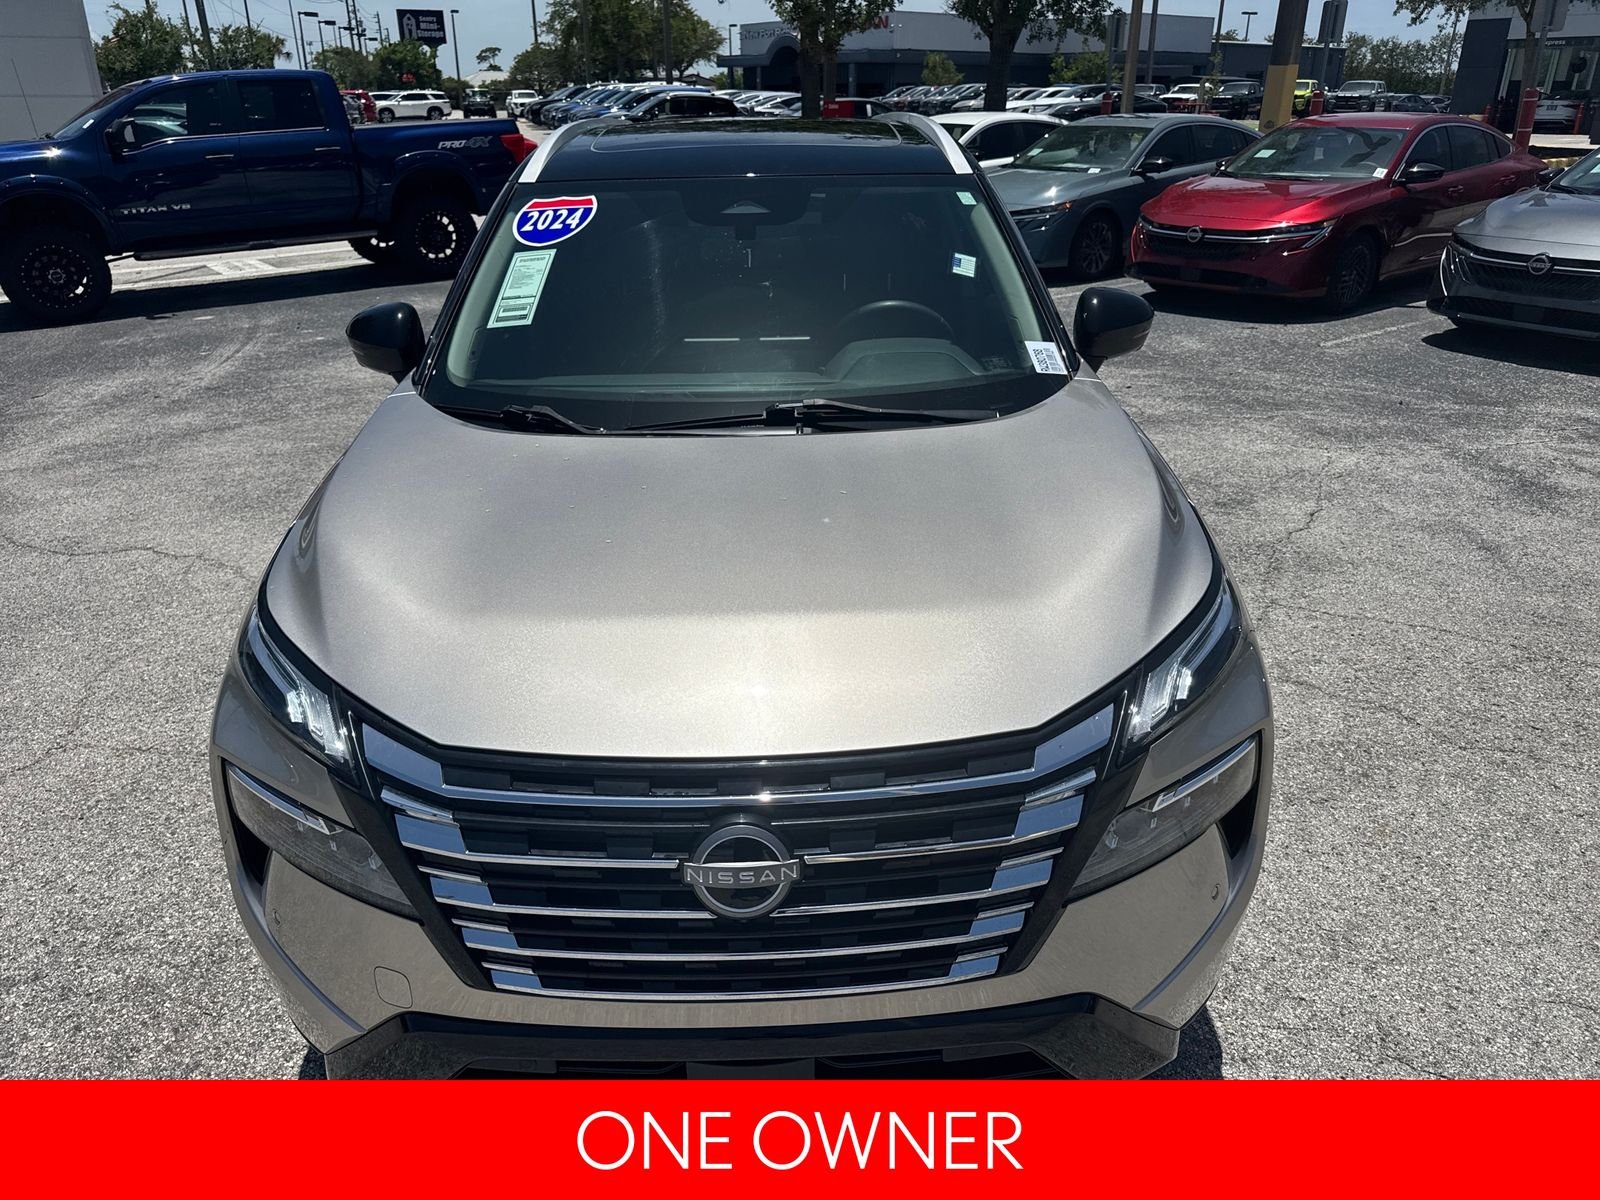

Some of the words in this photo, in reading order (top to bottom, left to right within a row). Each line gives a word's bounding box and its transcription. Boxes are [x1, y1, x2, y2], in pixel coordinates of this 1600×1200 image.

[416, 30, 444, 38] Storage
[120, 205, 167, 214] TITAN
[520, 208, 584, 232] 2024
[687, 865, 797, 884] NISSAN
